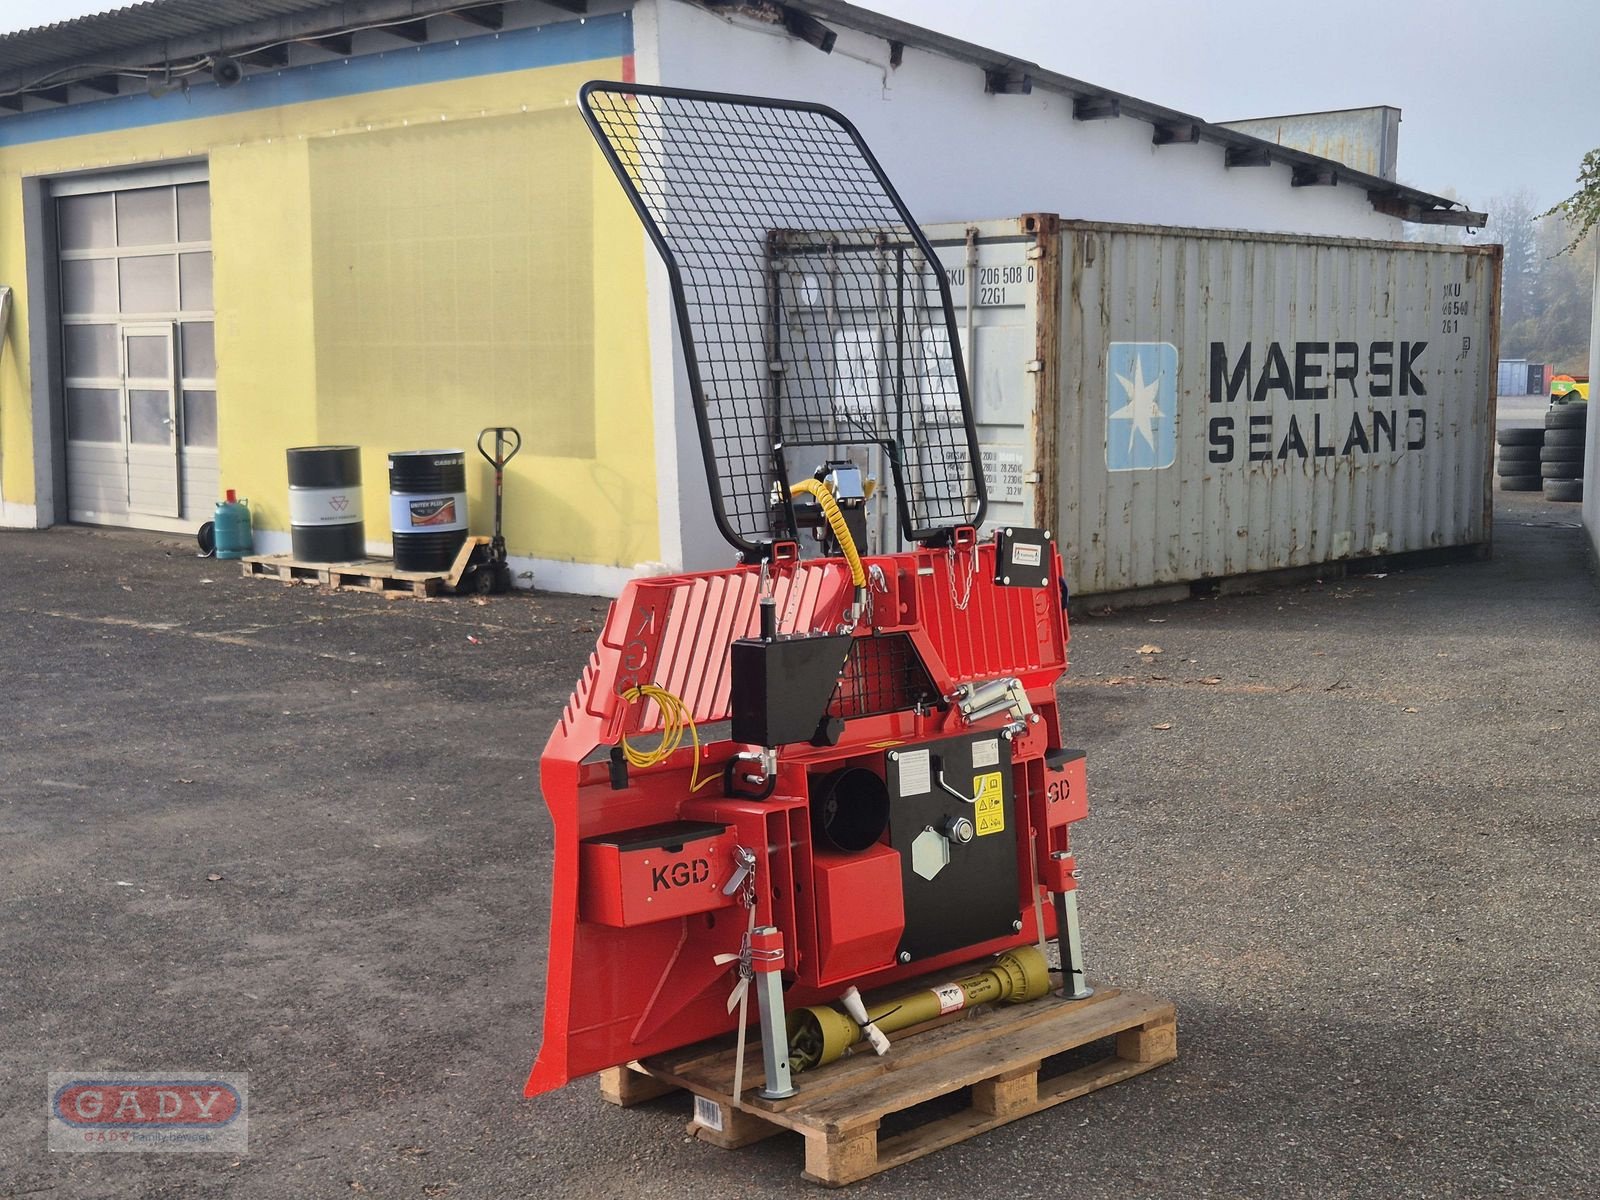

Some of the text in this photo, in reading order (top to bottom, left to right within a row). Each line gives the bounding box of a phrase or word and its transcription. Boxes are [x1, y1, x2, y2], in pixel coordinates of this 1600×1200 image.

[980, 268, 1000, 285] 206
[1003, 267, 1022, 284] 508
[1027, 266, 1034, 282] 0
[980, 287, 1006, 304] 22G1
[1209, 341, 1428, 403] MAERSK
[1208, 409, 1427, 464] SEALAND
[652, 858, 709, 892] KGD
